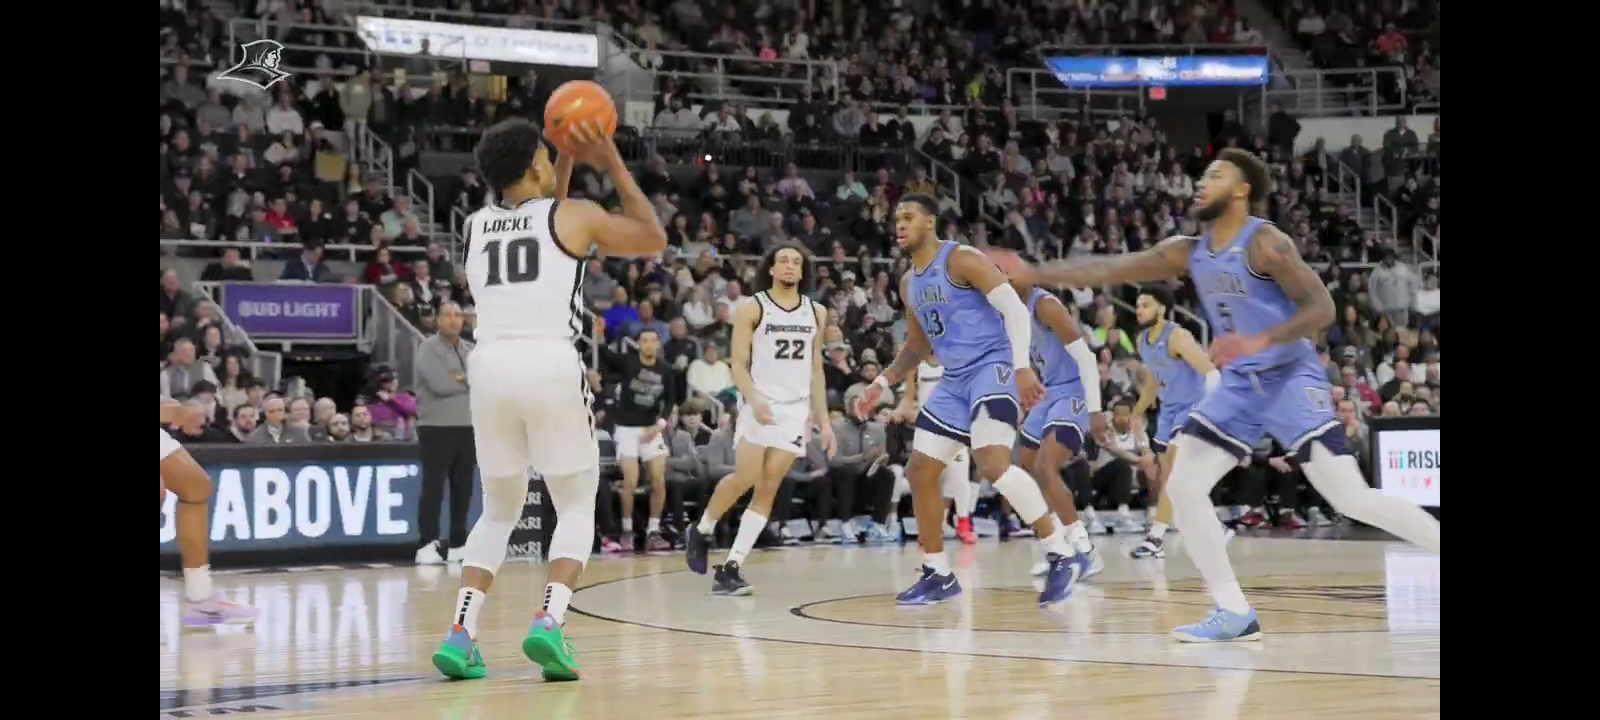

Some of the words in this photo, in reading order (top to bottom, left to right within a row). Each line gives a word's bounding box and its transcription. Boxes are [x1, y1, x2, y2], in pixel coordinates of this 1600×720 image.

[482, 215, 532, 234] LOCKE
[482, 237, 540, 287] 10
[238, 301, 280, 317] BUD
[283, 301, 341, 317] LIGHT
[774, 338, 805, 360] 22
